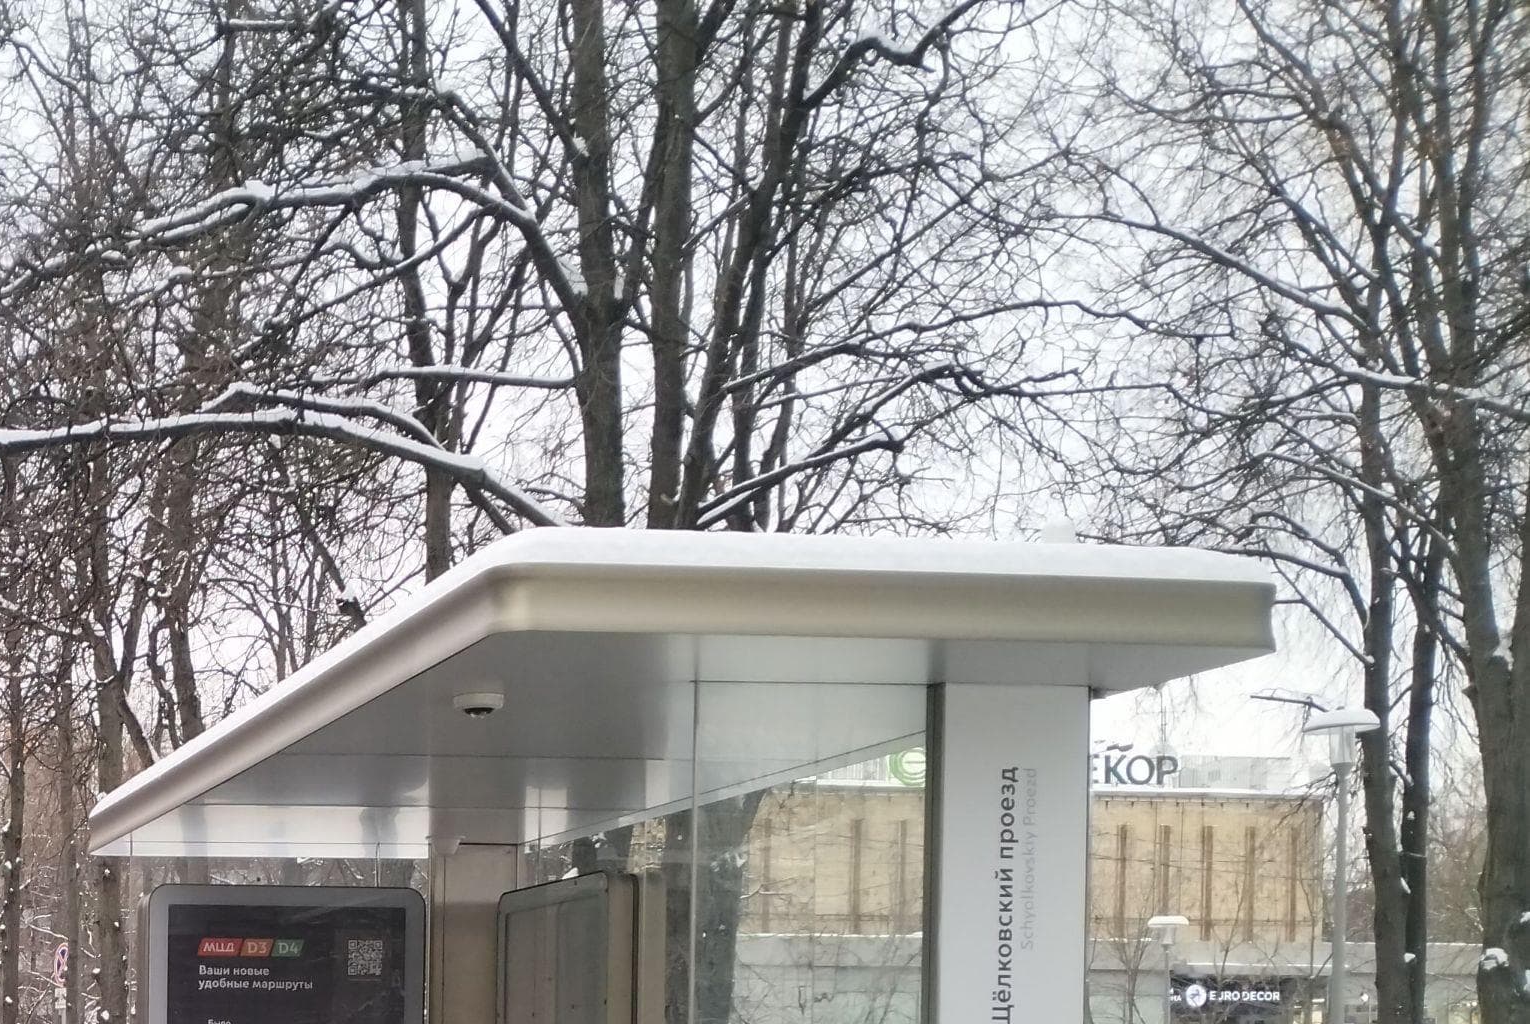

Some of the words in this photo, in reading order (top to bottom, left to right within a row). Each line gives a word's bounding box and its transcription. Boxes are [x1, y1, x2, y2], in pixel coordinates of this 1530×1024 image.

[1023, 768, 1038, 825] Proezd
[1000, 767, 1019, 859] проезд
[203, 942, 235, 952] МЦД
[247, 942, 267, 954] D3
[278, 942, 298, 954] D4
[199, 965, 230, 976] Ваши
[233, 967, 270, 976] новые
[198, 978, 250, 990] удобные
[252, 981, 313, 991] маршруты
